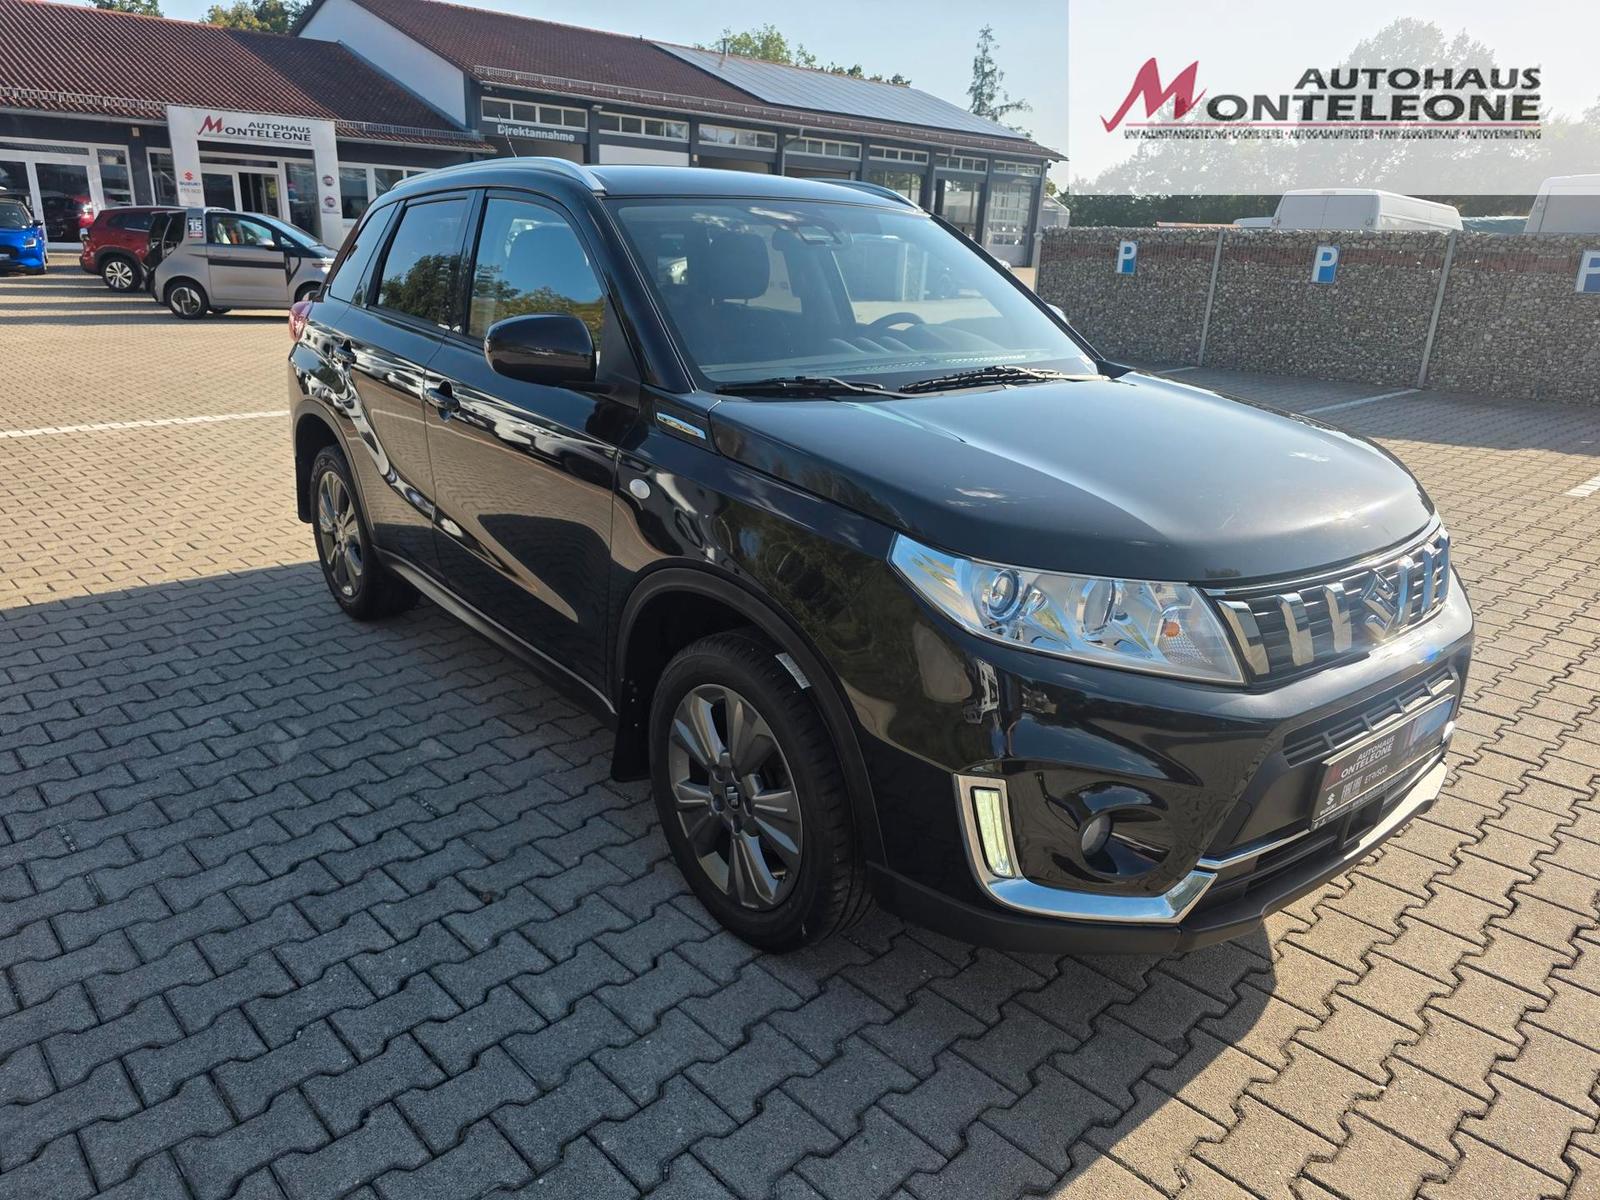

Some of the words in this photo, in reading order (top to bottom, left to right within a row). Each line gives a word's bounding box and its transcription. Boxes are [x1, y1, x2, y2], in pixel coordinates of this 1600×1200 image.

[197, 115, 312, 142] MONTELEONE
[248, 121, 311, 133] AUTOHAUS
[497, 124, 575, 142] Direktannahme
[188, 221, 202, 231] 15
[1116, 241, 1138, 274] P
[1311, 246, 1339, 283] P
[1356, 734, 1396, 761] AUTOHAUS
